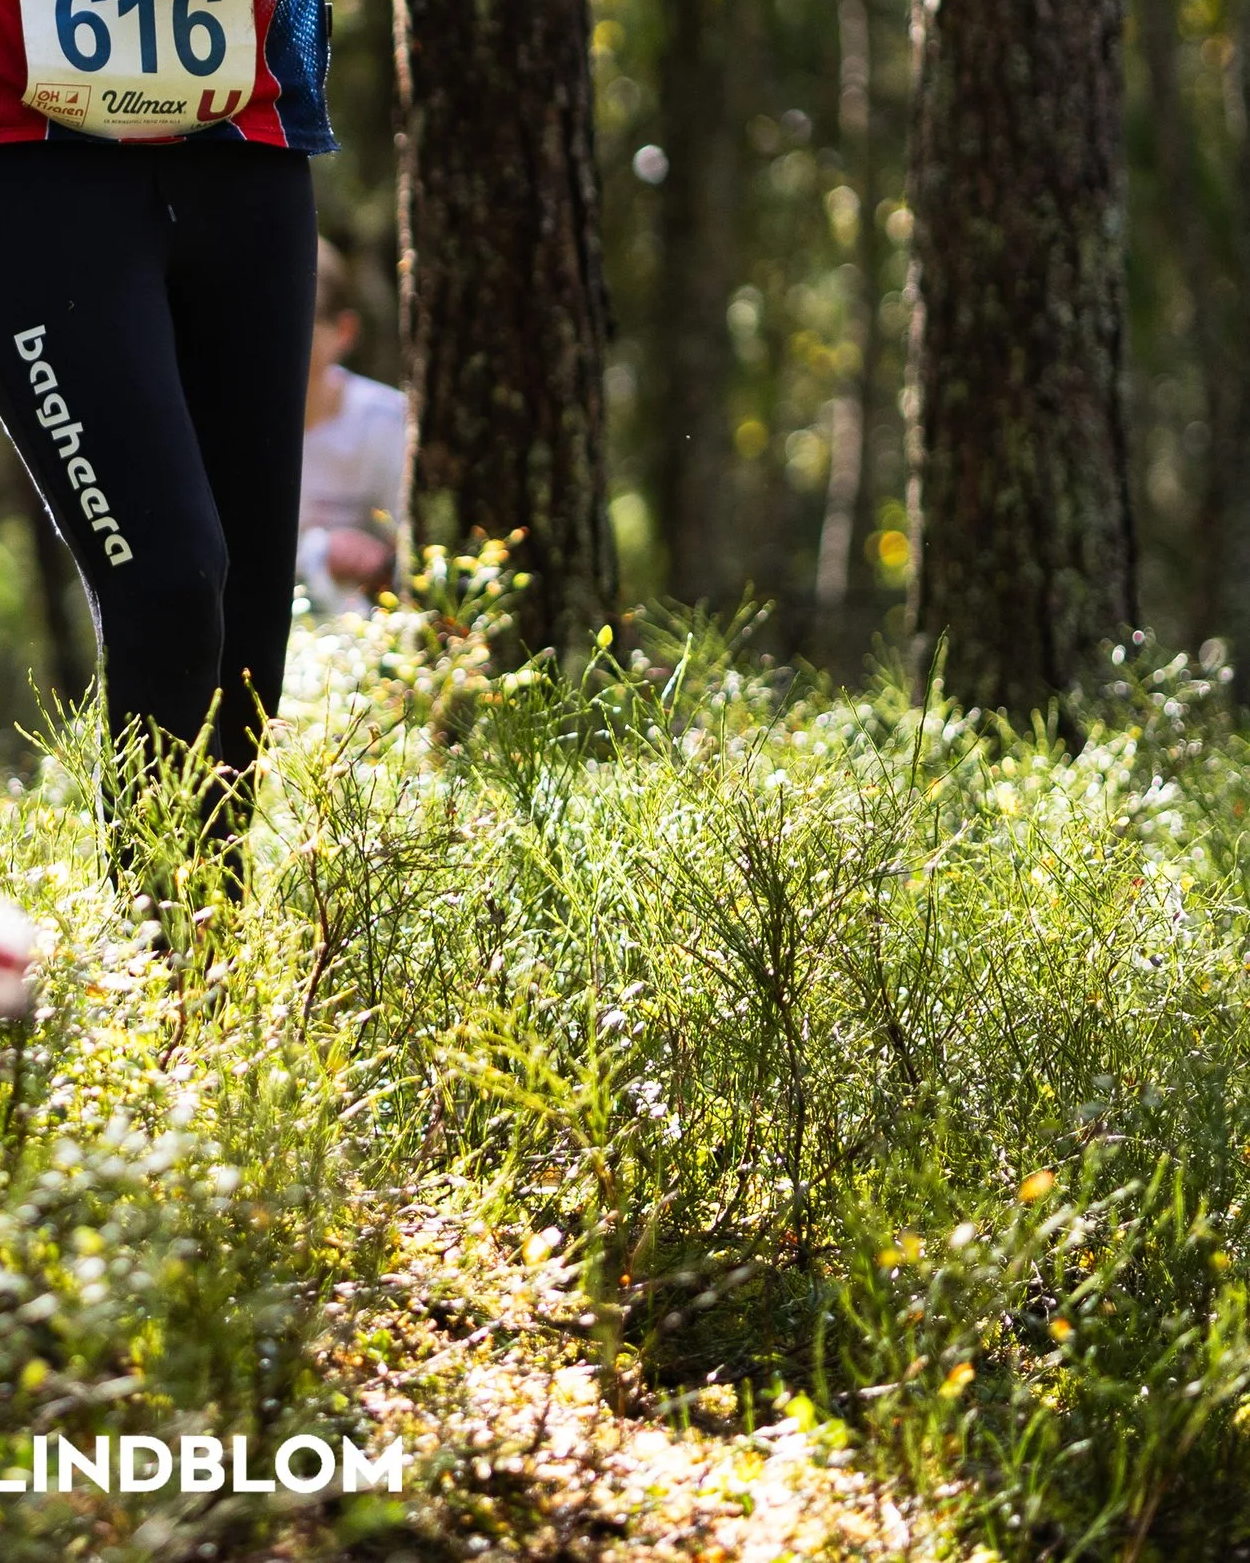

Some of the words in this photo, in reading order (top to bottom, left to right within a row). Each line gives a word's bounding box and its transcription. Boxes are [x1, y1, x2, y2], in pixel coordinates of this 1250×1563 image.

[35, 101, 84, 117] Tisaren
[101, 90, 188, 114] Ullmax
[13, 324, 134, 567] bagheera
